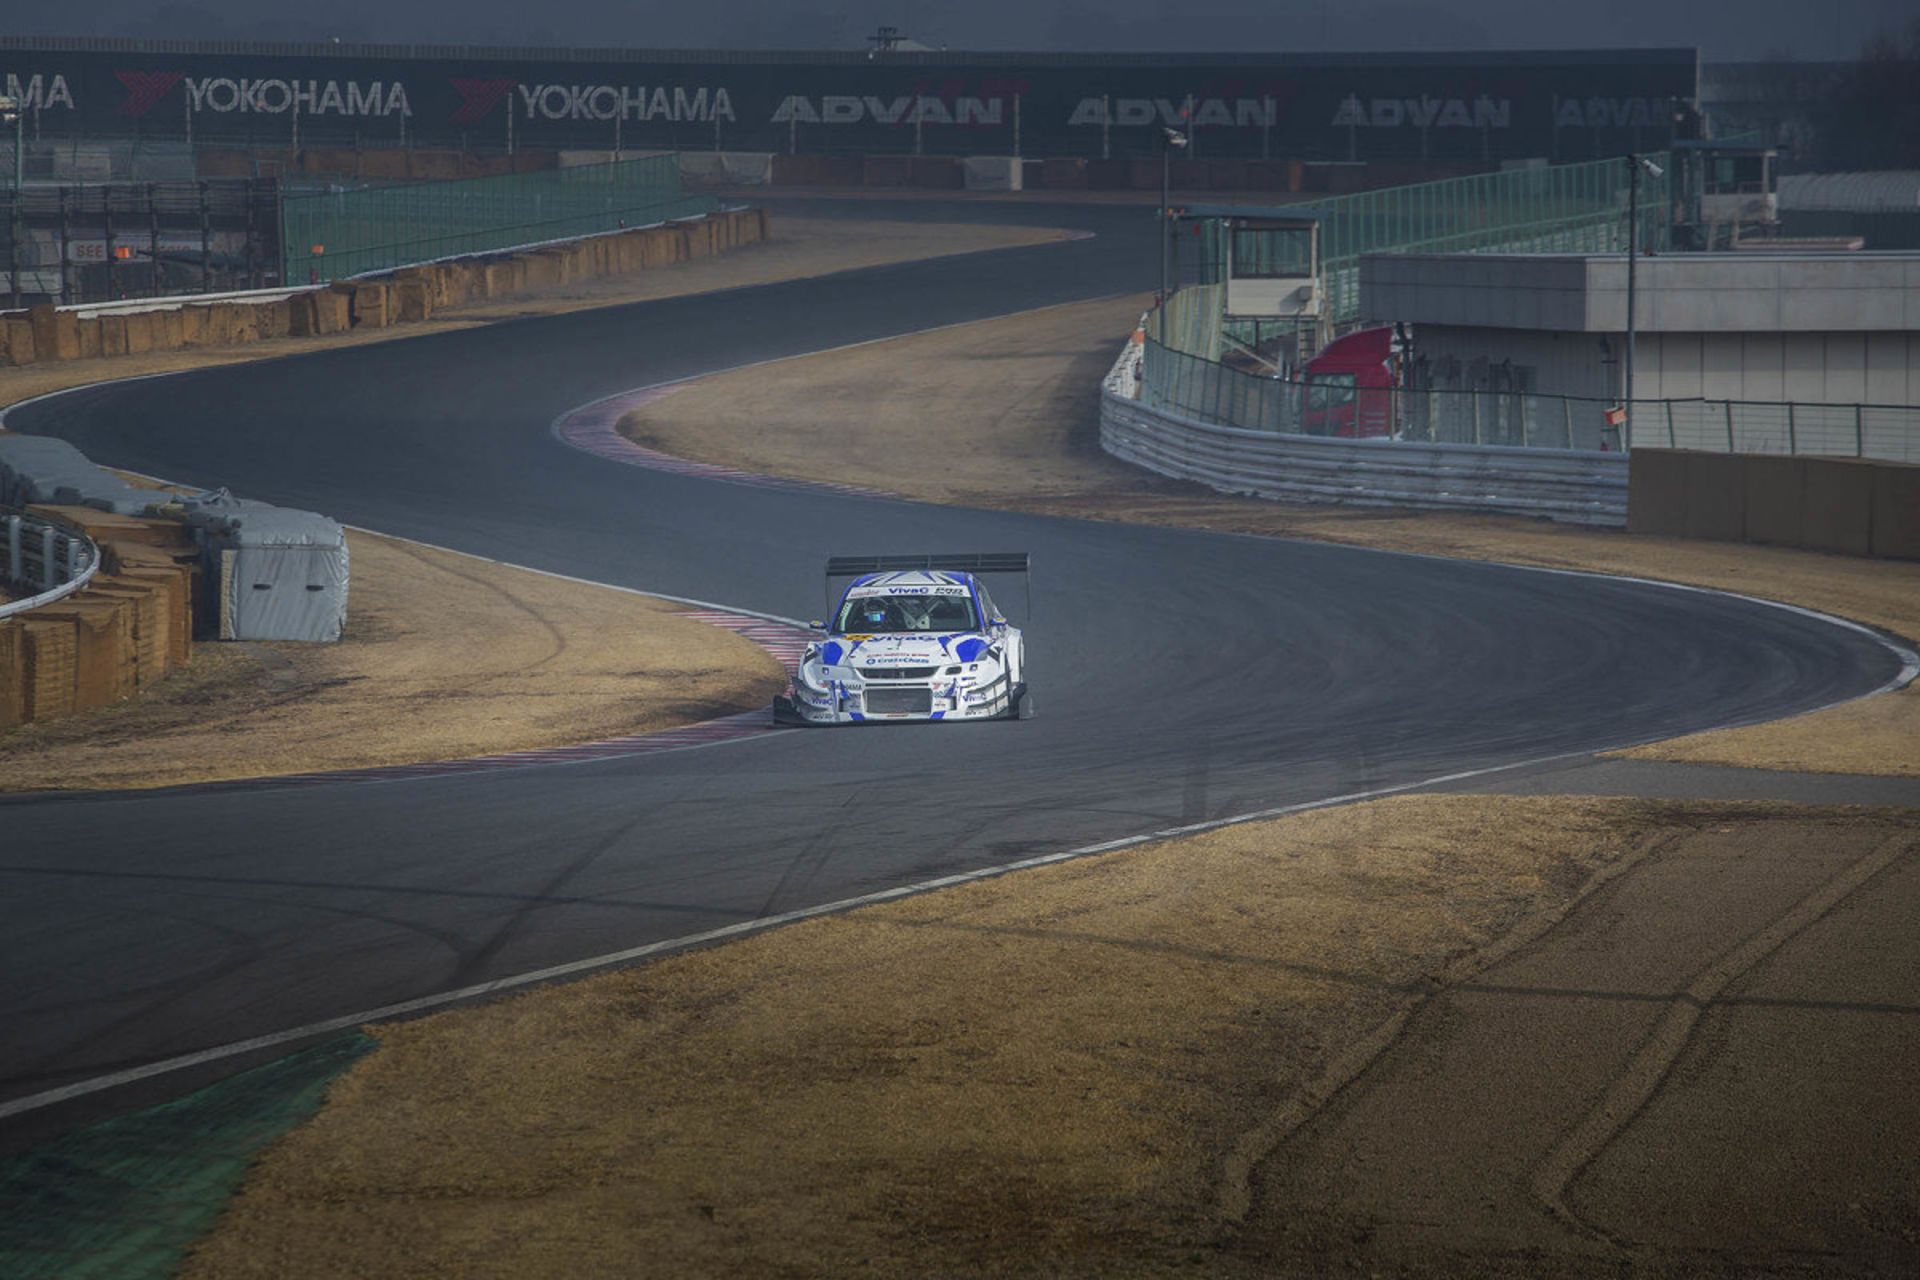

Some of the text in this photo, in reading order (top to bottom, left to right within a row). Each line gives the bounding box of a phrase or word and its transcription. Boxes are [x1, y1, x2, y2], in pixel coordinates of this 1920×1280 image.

[0, 73, 75, 109] MA
[185, 77, 413, 117] YOKOHAMA
[519, 84, 737, 123] YOKOHAMA
[770, 95, 1003, 125] ADVAN
[1067, 97, 1278, 127] ADVAN
[1331, 97, 1512, 128] ADVAN
